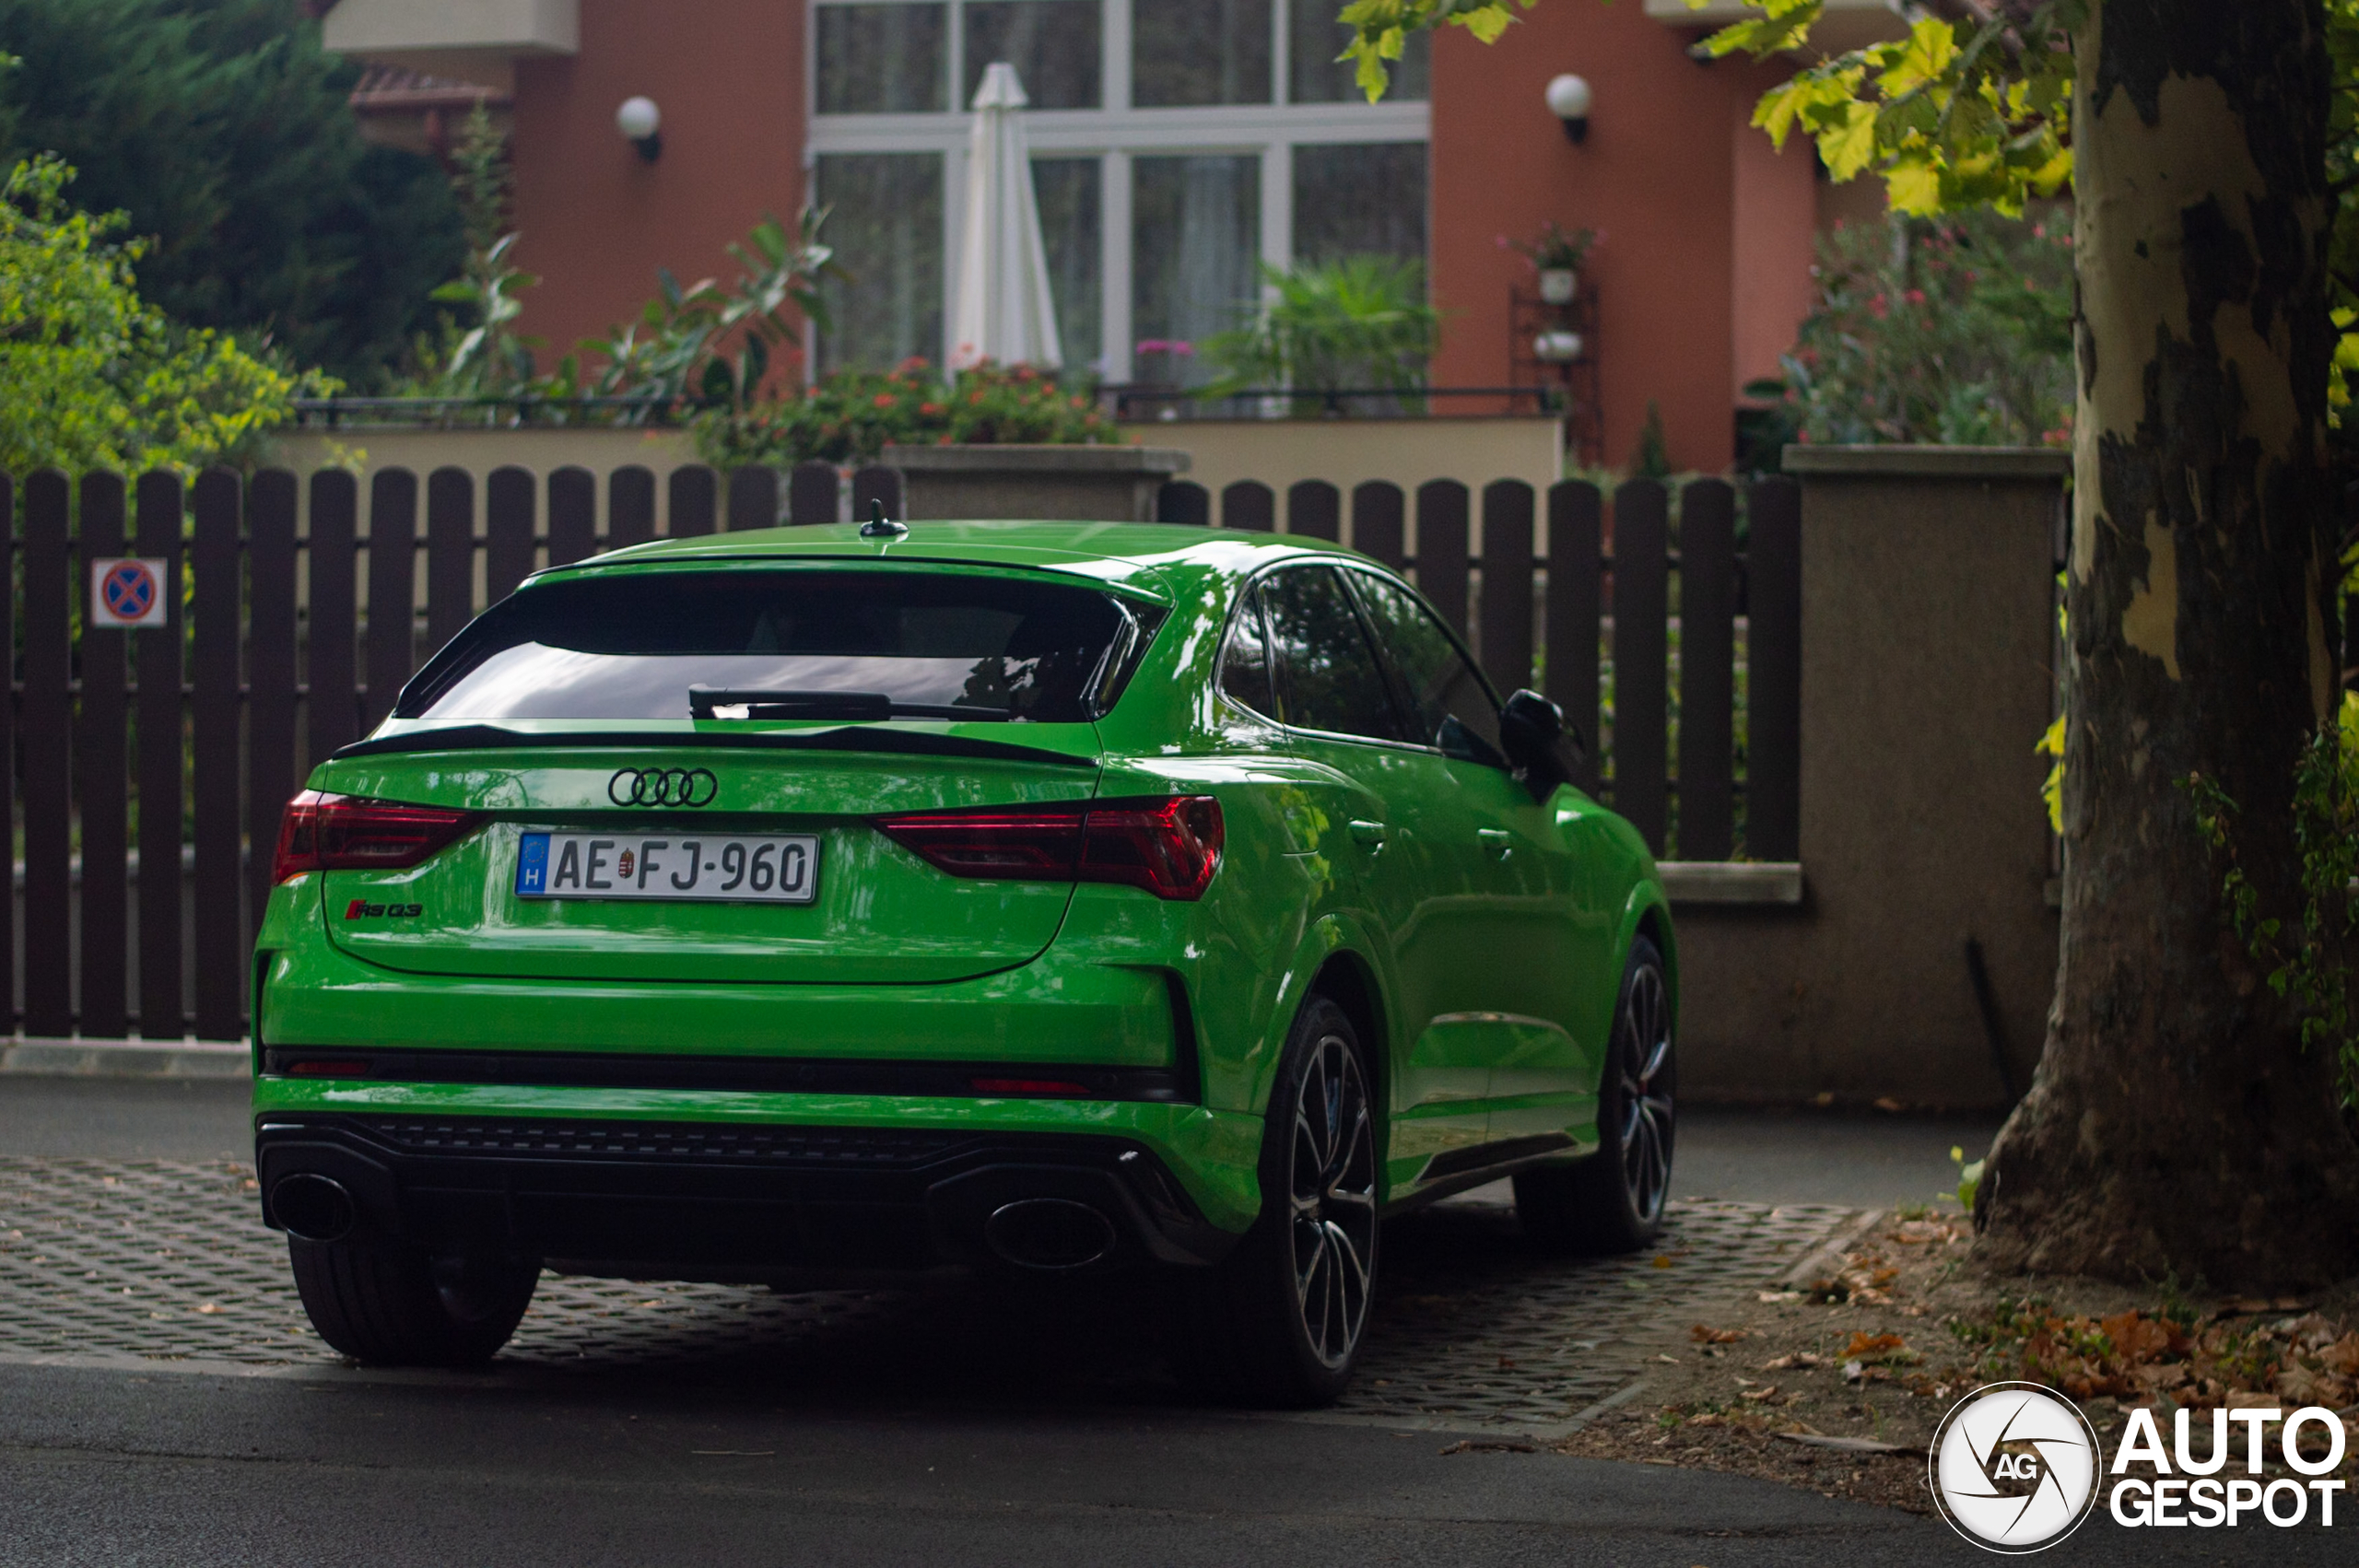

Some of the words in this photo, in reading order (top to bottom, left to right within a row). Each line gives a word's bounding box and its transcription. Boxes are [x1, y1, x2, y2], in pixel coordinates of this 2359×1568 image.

[524, 868, 539, 886] H
[351, 903, 386, 918] RS
[388, 904, 423, 918] Q3
